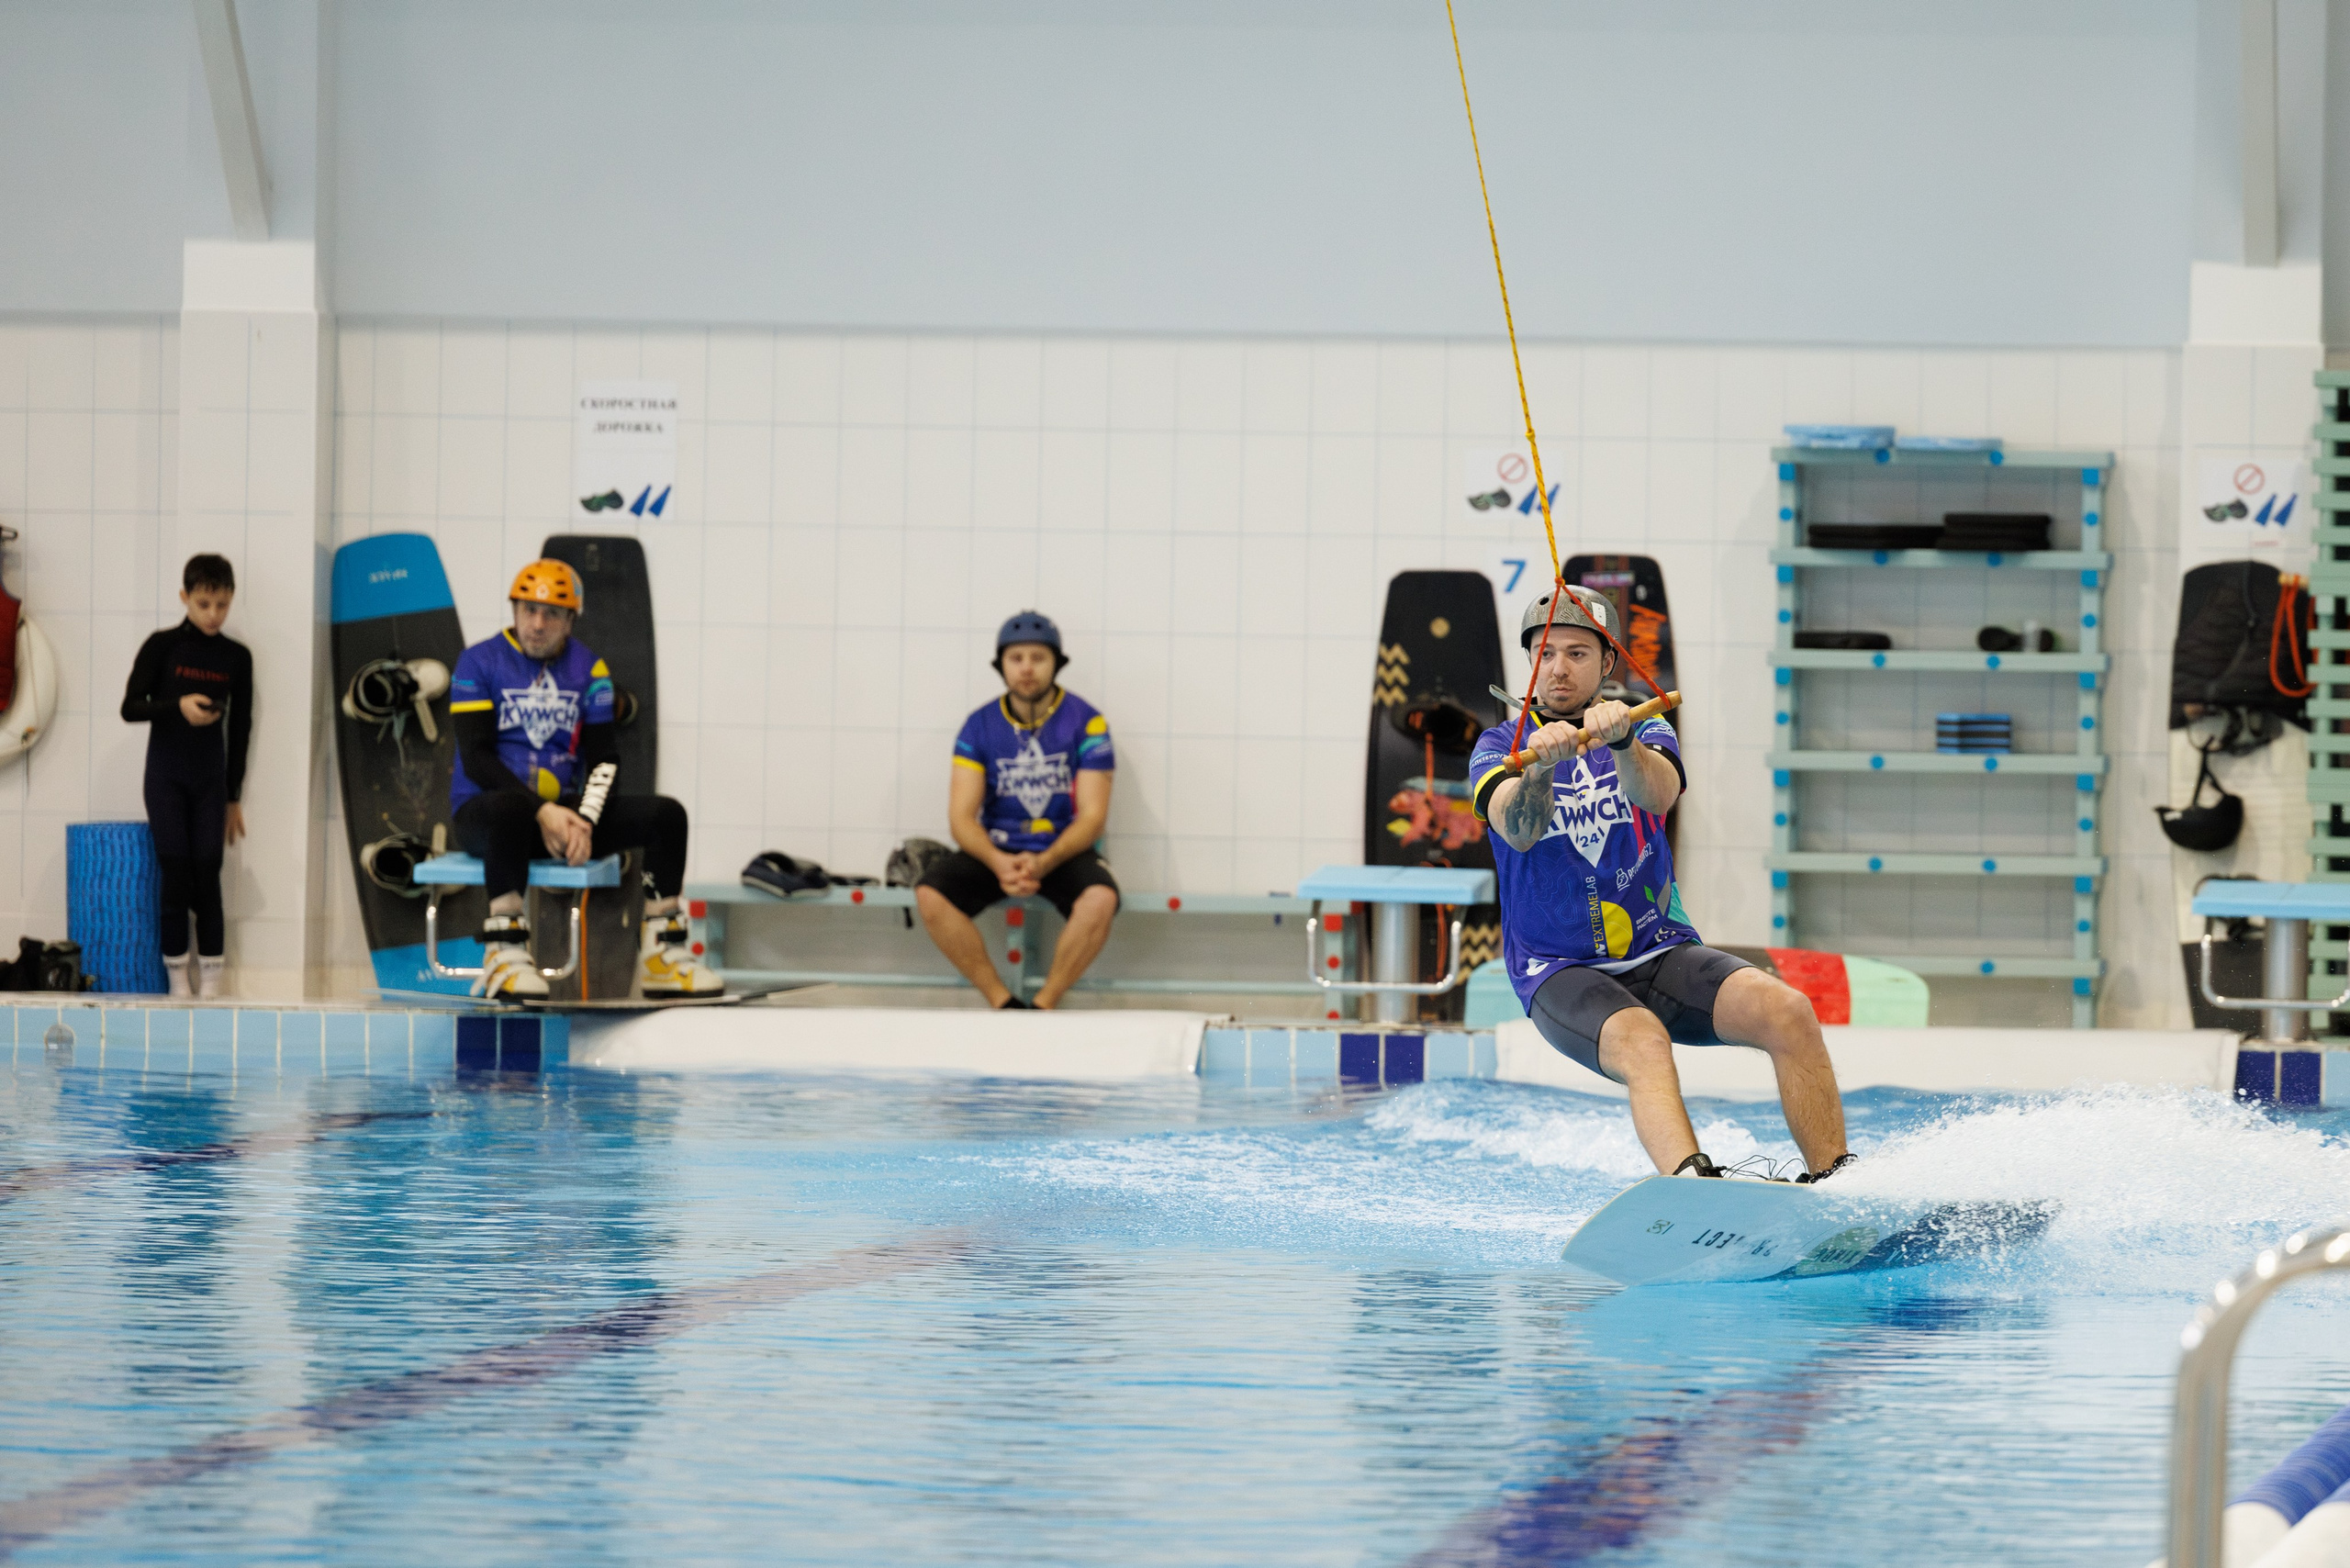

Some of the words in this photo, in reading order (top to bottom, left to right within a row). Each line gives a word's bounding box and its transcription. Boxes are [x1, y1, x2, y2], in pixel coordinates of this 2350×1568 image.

[580, 398, 677, 409] СКОРОСТНАЯ
[593, 421, 663, 433] ДОРОЖКА
[1502, 559, 1526, 592] 7
[1585, 876, 1604, 942] EXTREMELAB
